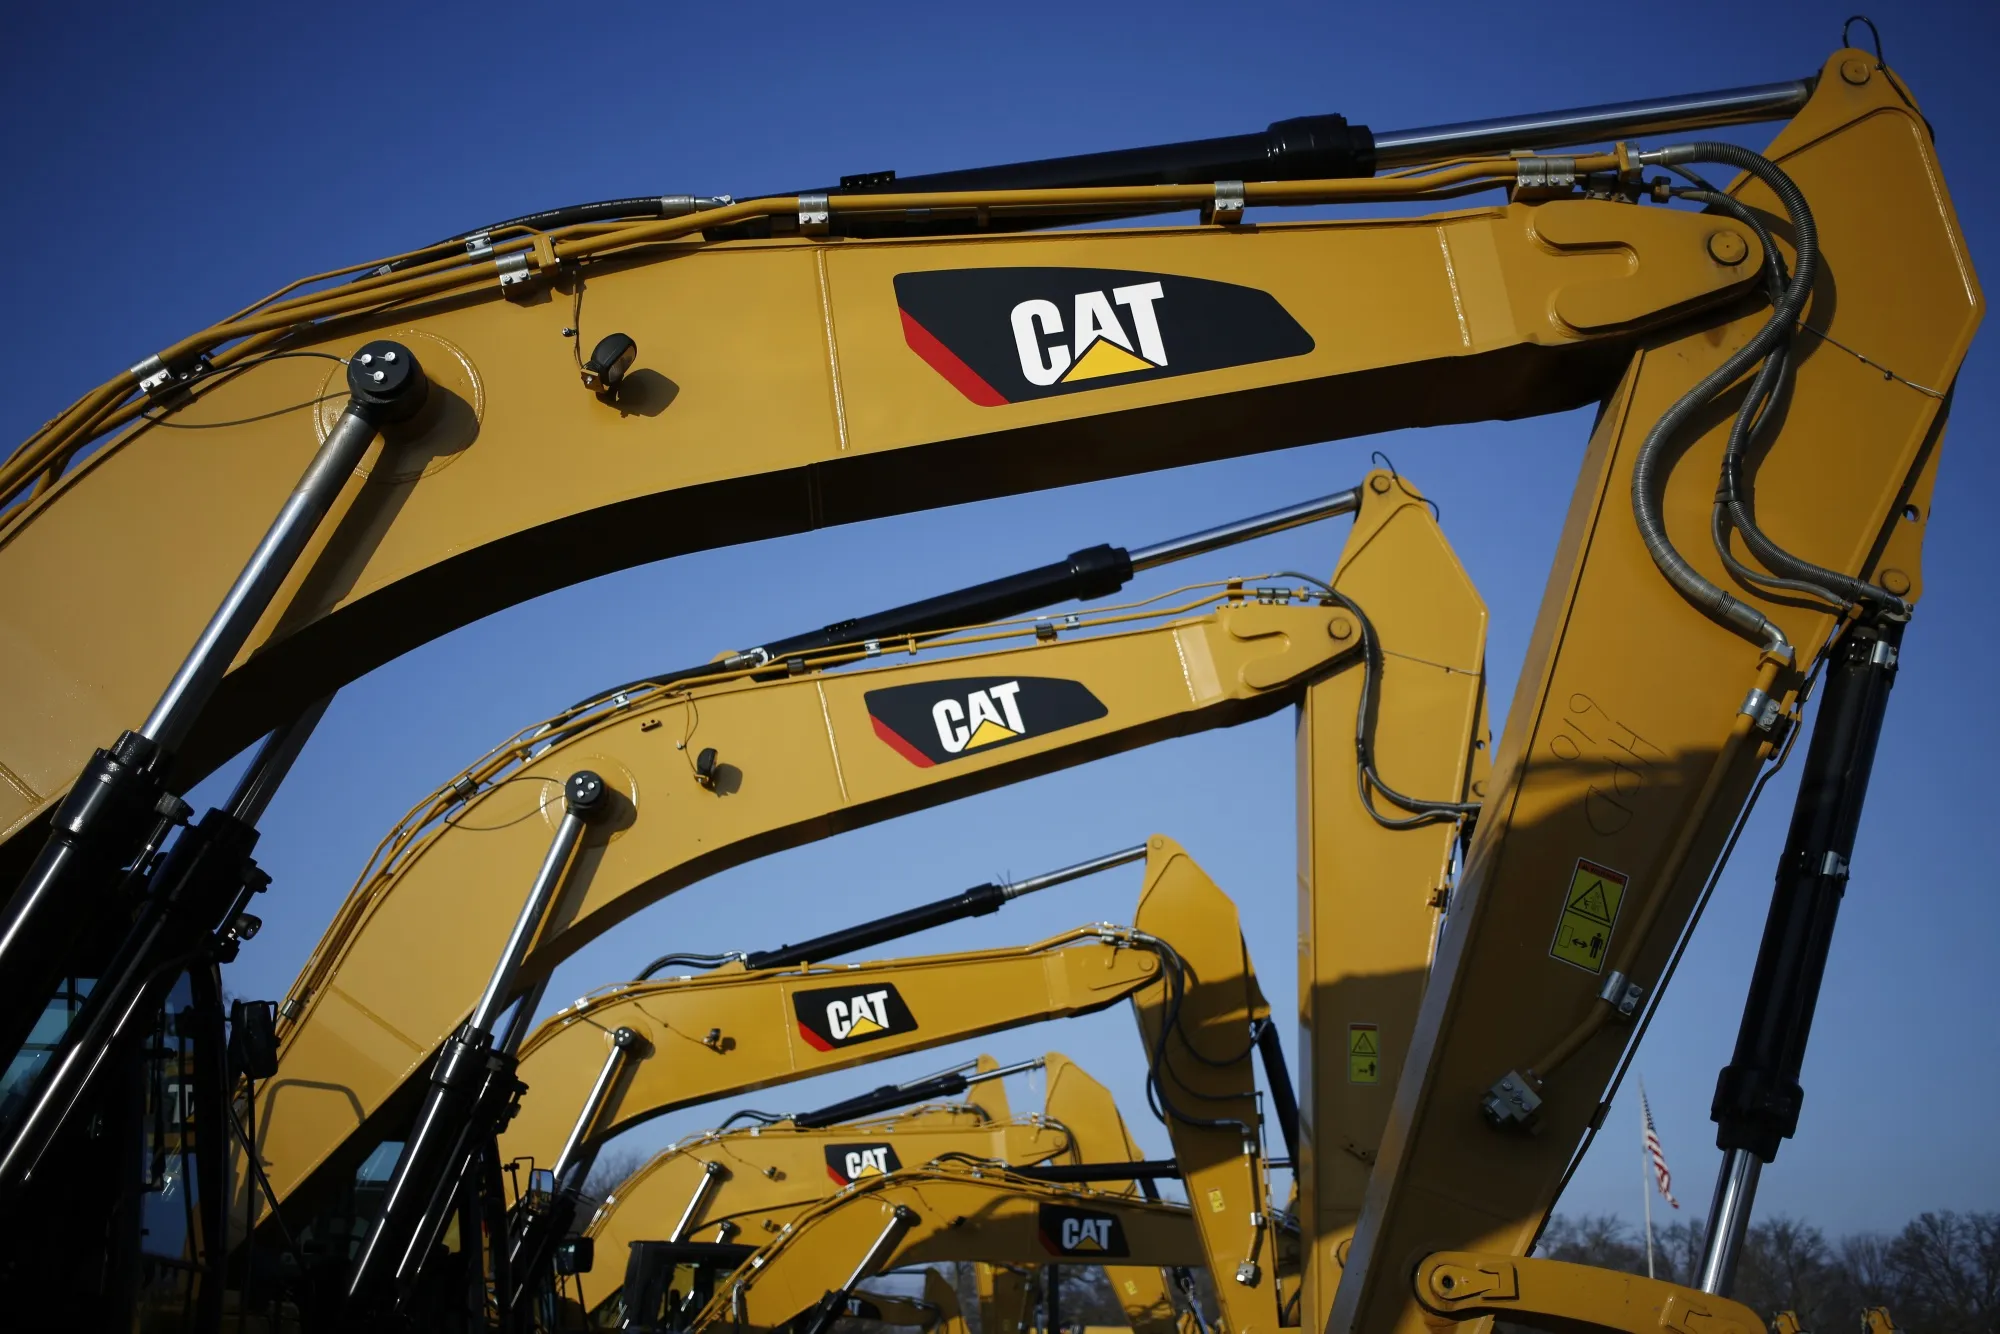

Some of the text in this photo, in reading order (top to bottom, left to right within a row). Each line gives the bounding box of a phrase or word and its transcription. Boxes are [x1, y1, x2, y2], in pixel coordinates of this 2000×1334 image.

[1010, 281, 1168, 386] CAT
[932, 680, 1026, 753] CAT
[826, 989, 889, 1040] CAT
[845, 1147, 888, 1179] CAT
[1062, 1218, 1112, 1250] CAT
